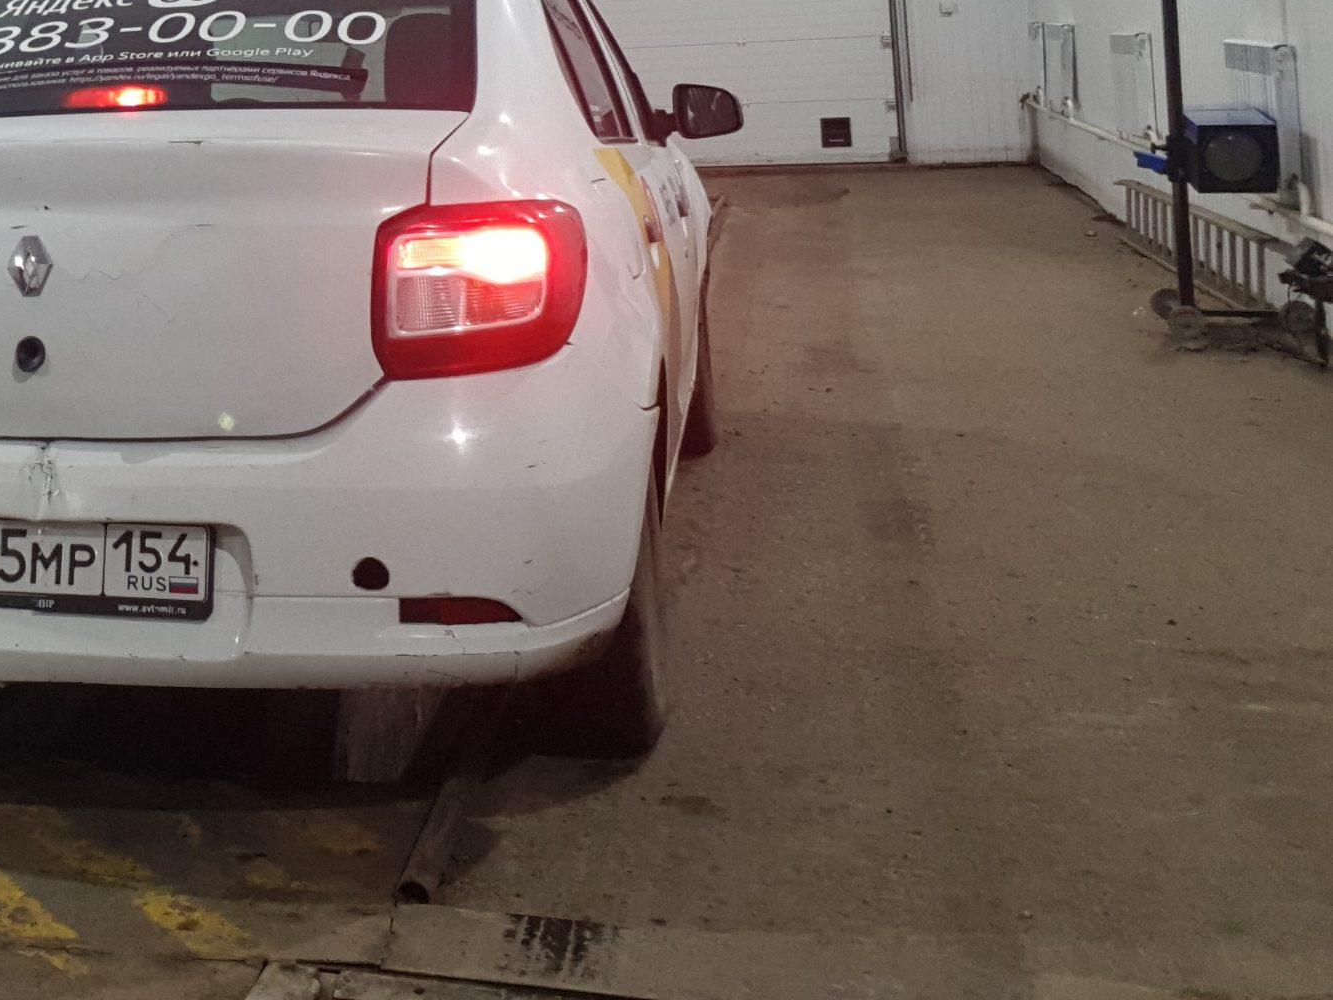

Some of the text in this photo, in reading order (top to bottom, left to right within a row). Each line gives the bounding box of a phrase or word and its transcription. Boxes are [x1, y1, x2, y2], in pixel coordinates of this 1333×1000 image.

[78, 53, 114, 63] App
[118, 51, 164, 60] Store
[167, 50, 202, 58] или
[206, 47, 270, 58] Google
[275, 47, 314, 58] Play
[112, 530, 194, 575] 154
[127, 576, 166, 592] RUS
